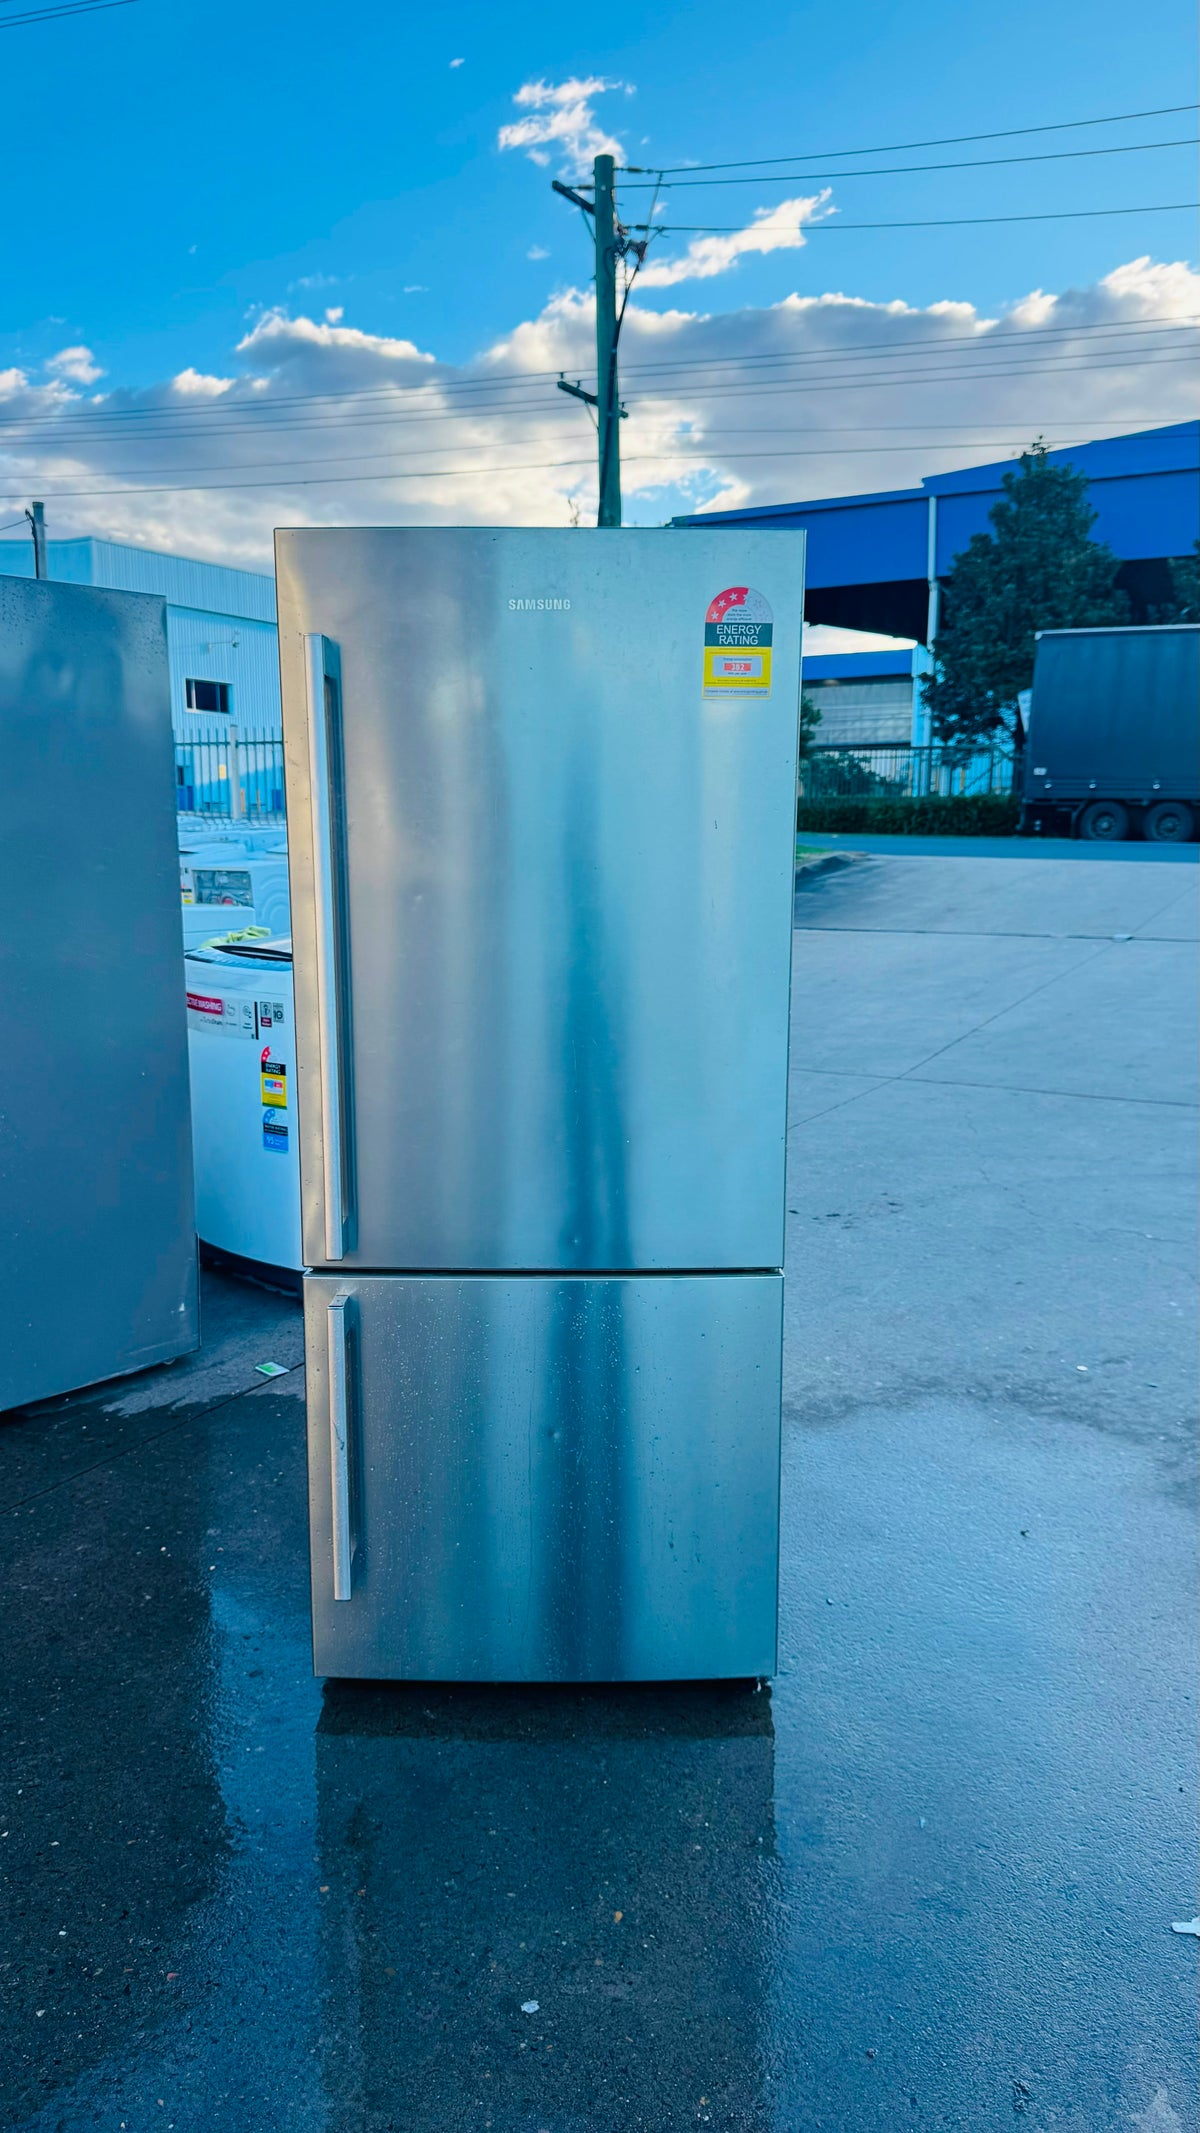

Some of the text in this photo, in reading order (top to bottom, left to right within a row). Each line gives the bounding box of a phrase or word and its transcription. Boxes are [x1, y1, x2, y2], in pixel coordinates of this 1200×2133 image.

[508, 598, 571, 610] SAMSUNG
[716, 625, 762, 635] ENERGY
[719, 635, 759, 645] RATING
